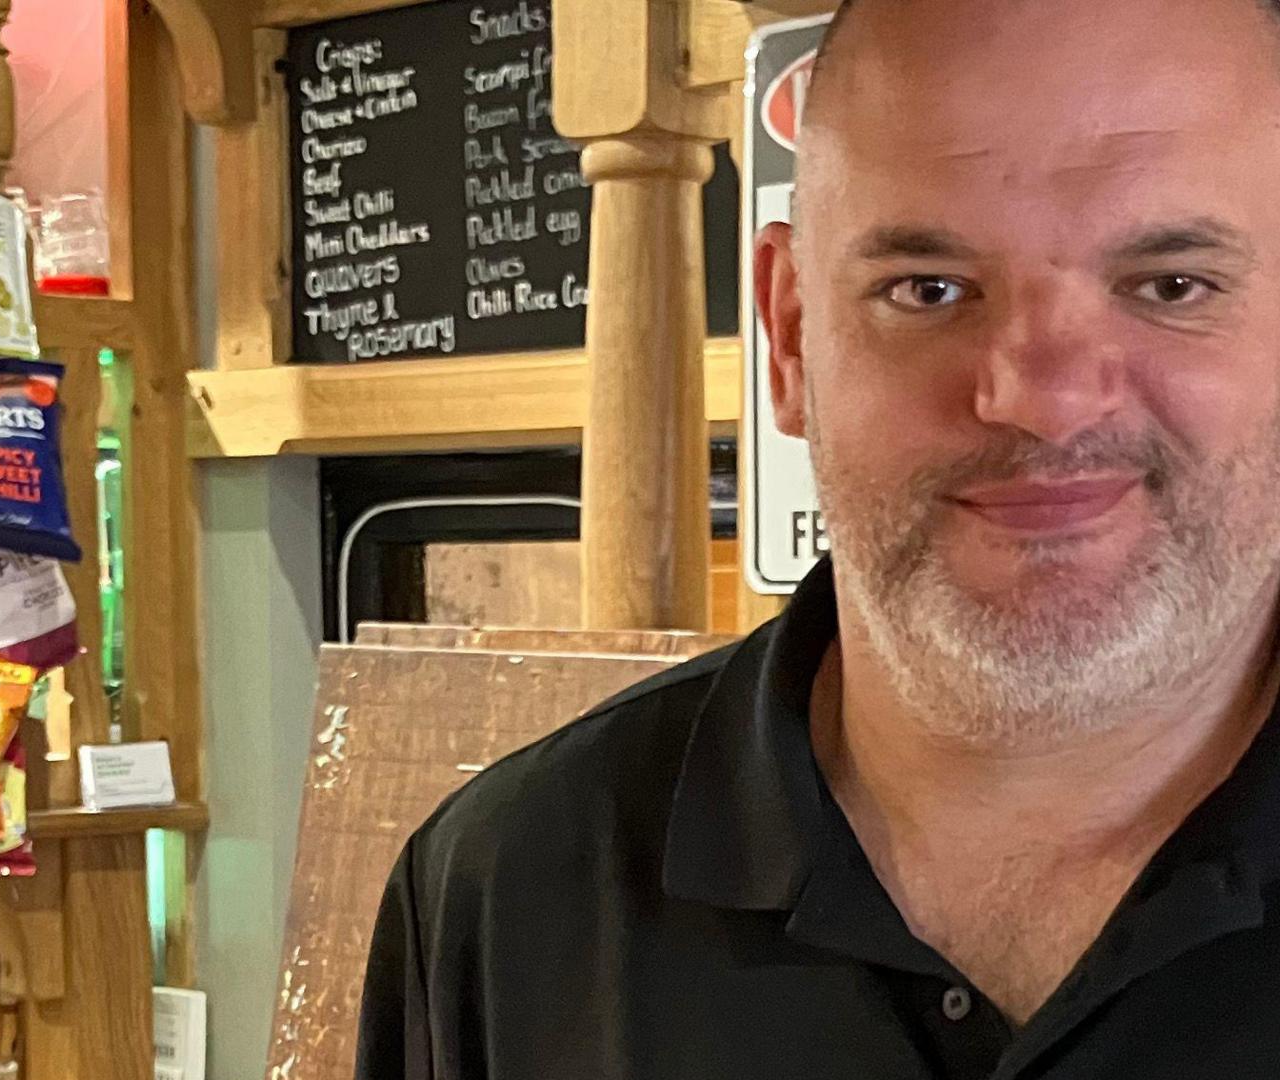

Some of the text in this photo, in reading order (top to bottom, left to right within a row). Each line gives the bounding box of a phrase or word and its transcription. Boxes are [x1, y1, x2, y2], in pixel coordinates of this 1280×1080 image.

[304, 188, 394, 227] Sweet Chilli
[546, 210, 581, 246] egg
[305, 219, 430, 262] Mini Cheddars
[305, 254, 400, 299] Quavers
[304, 298, 379, 341] Thyme
[467, 288, 512, 319] Chilli
[514, 280, 558, 313] Rice
[792, 511, 831, 558] FE
